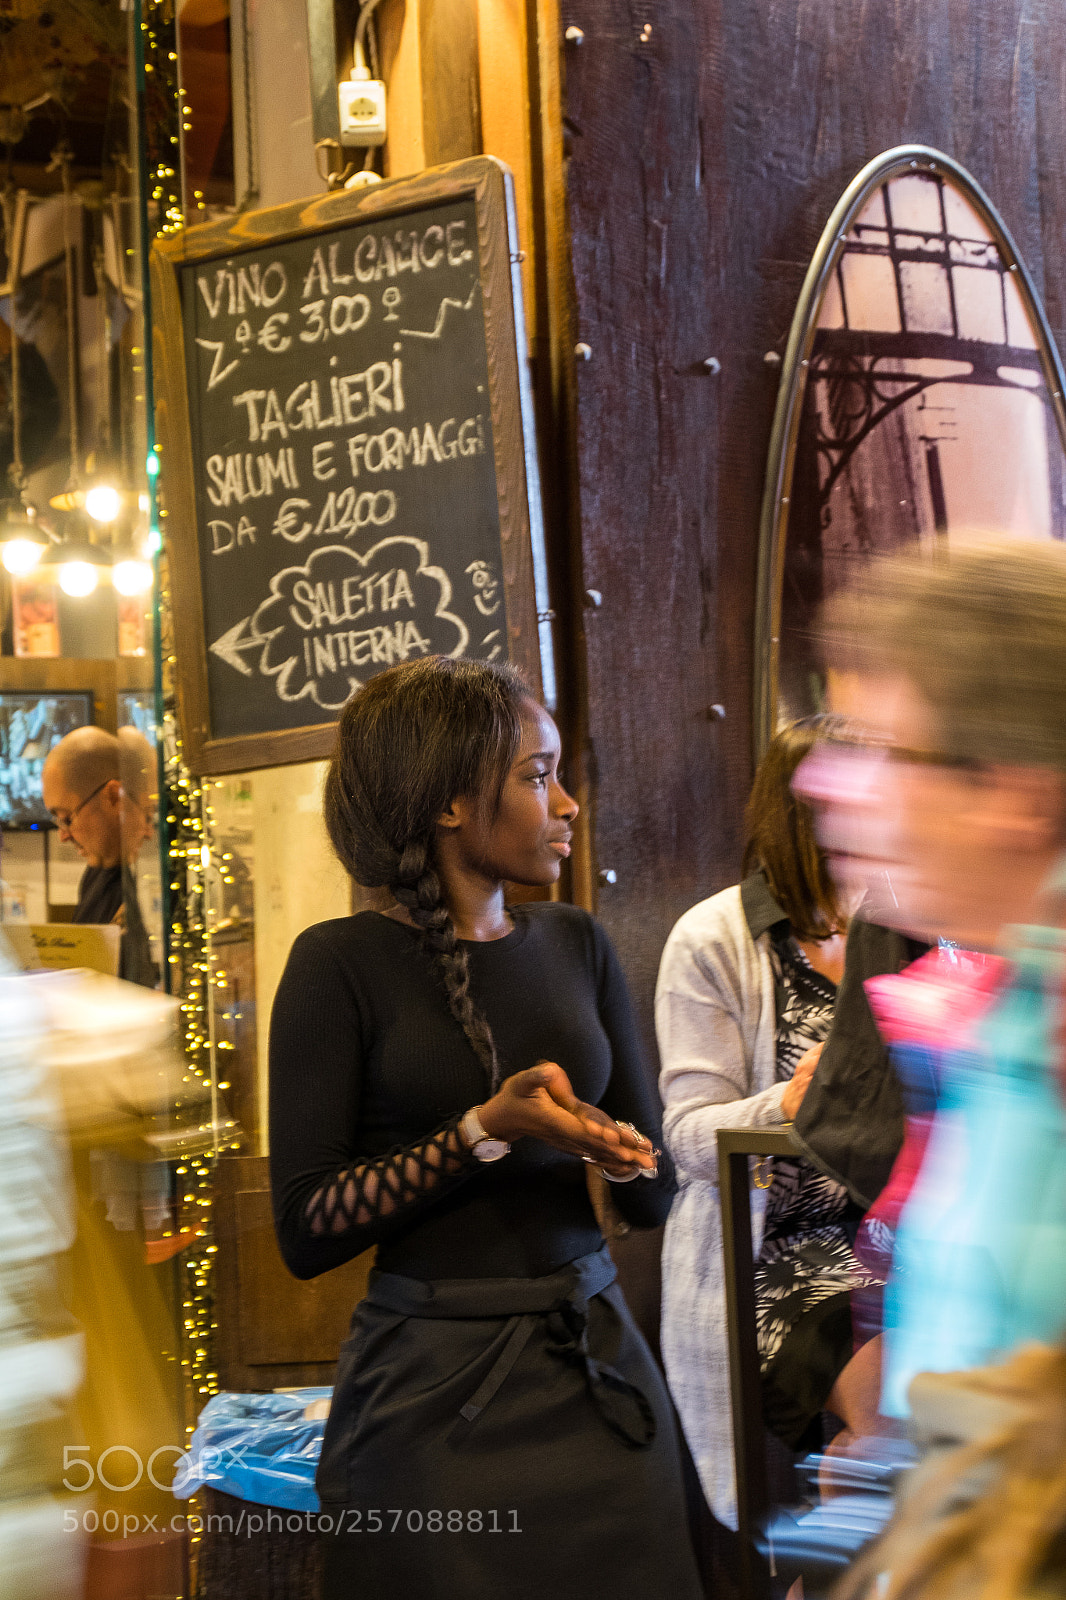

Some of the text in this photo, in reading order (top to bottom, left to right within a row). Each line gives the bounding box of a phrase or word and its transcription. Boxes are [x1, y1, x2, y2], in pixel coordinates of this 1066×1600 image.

[299, 293, 371, 343] 3,00
[232, 342, 405, 441] TAGLIERI
[206, 447, 299, 506] SALUMI
[312, 441, 337, 480] E
[207, 516, 256, 555] DA
[289, 568, 415, 630] SALETTA
[303, 620, 431, 676] INTERNA
